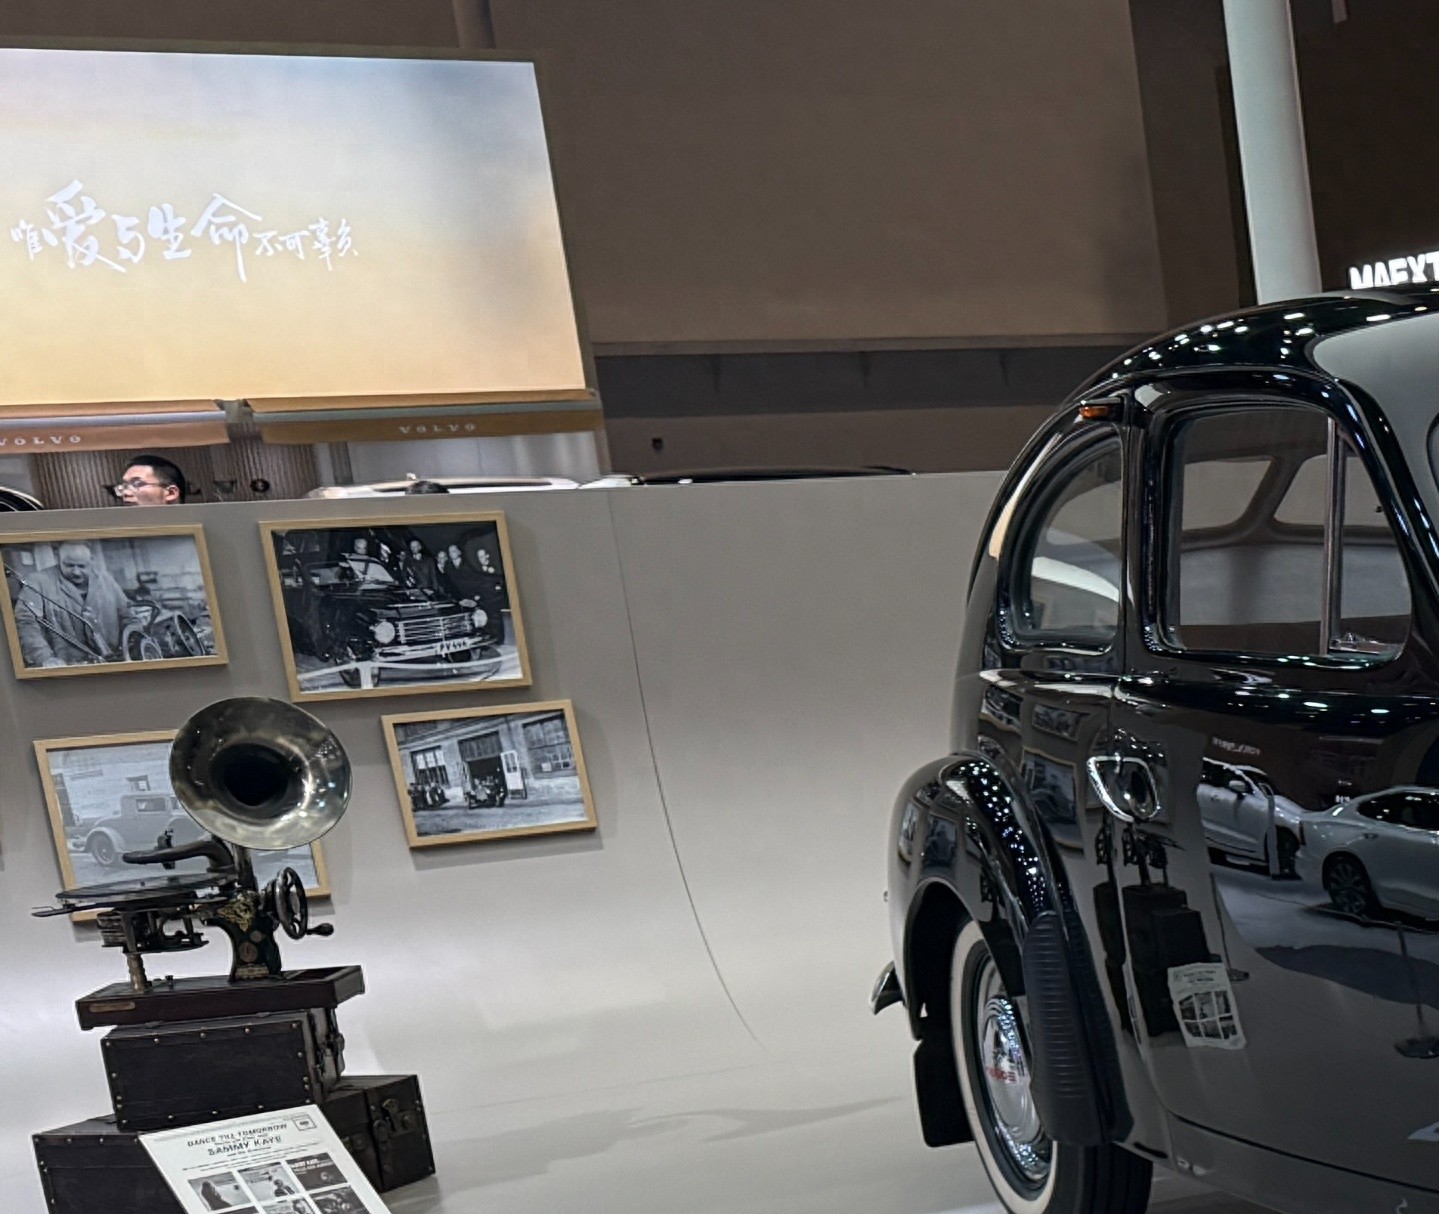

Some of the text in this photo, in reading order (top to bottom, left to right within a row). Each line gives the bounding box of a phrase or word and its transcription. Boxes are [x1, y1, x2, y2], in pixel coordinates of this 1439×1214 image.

[10, 179, 359, 283] 唯爱与生命不可辜负
[399, 423, 476, 434] VOLVO
